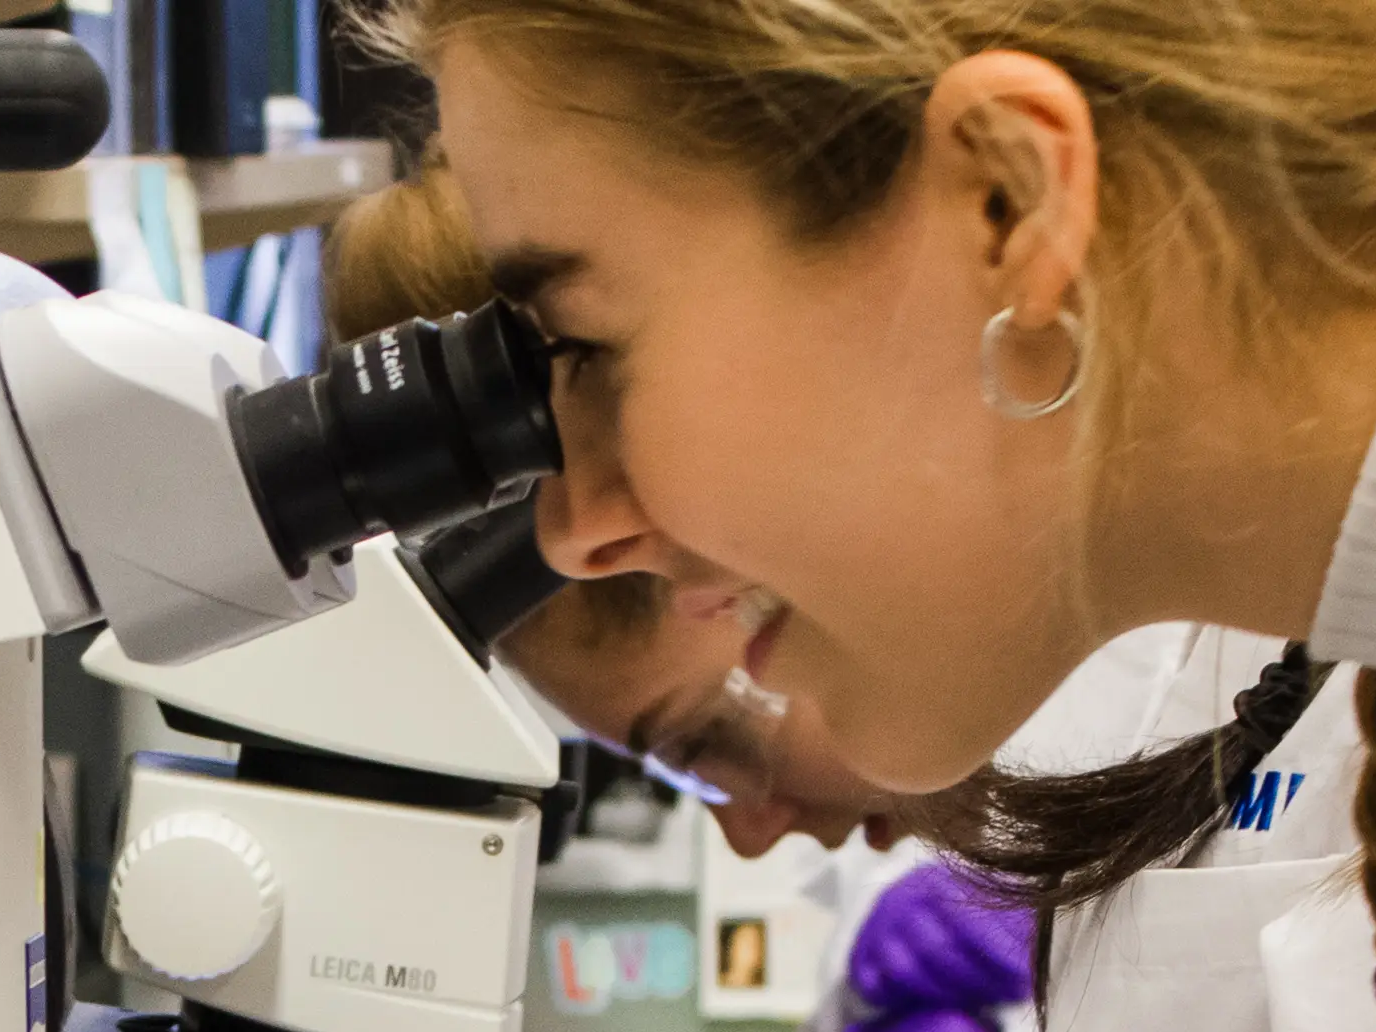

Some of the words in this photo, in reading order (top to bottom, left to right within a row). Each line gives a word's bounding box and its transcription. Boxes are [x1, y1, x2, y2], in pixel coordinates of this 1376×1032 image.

[381, 344, 405, 391] Zeiss
[309, 954, 376, 985] LEICA
[384, 963, 438, 992] M80
